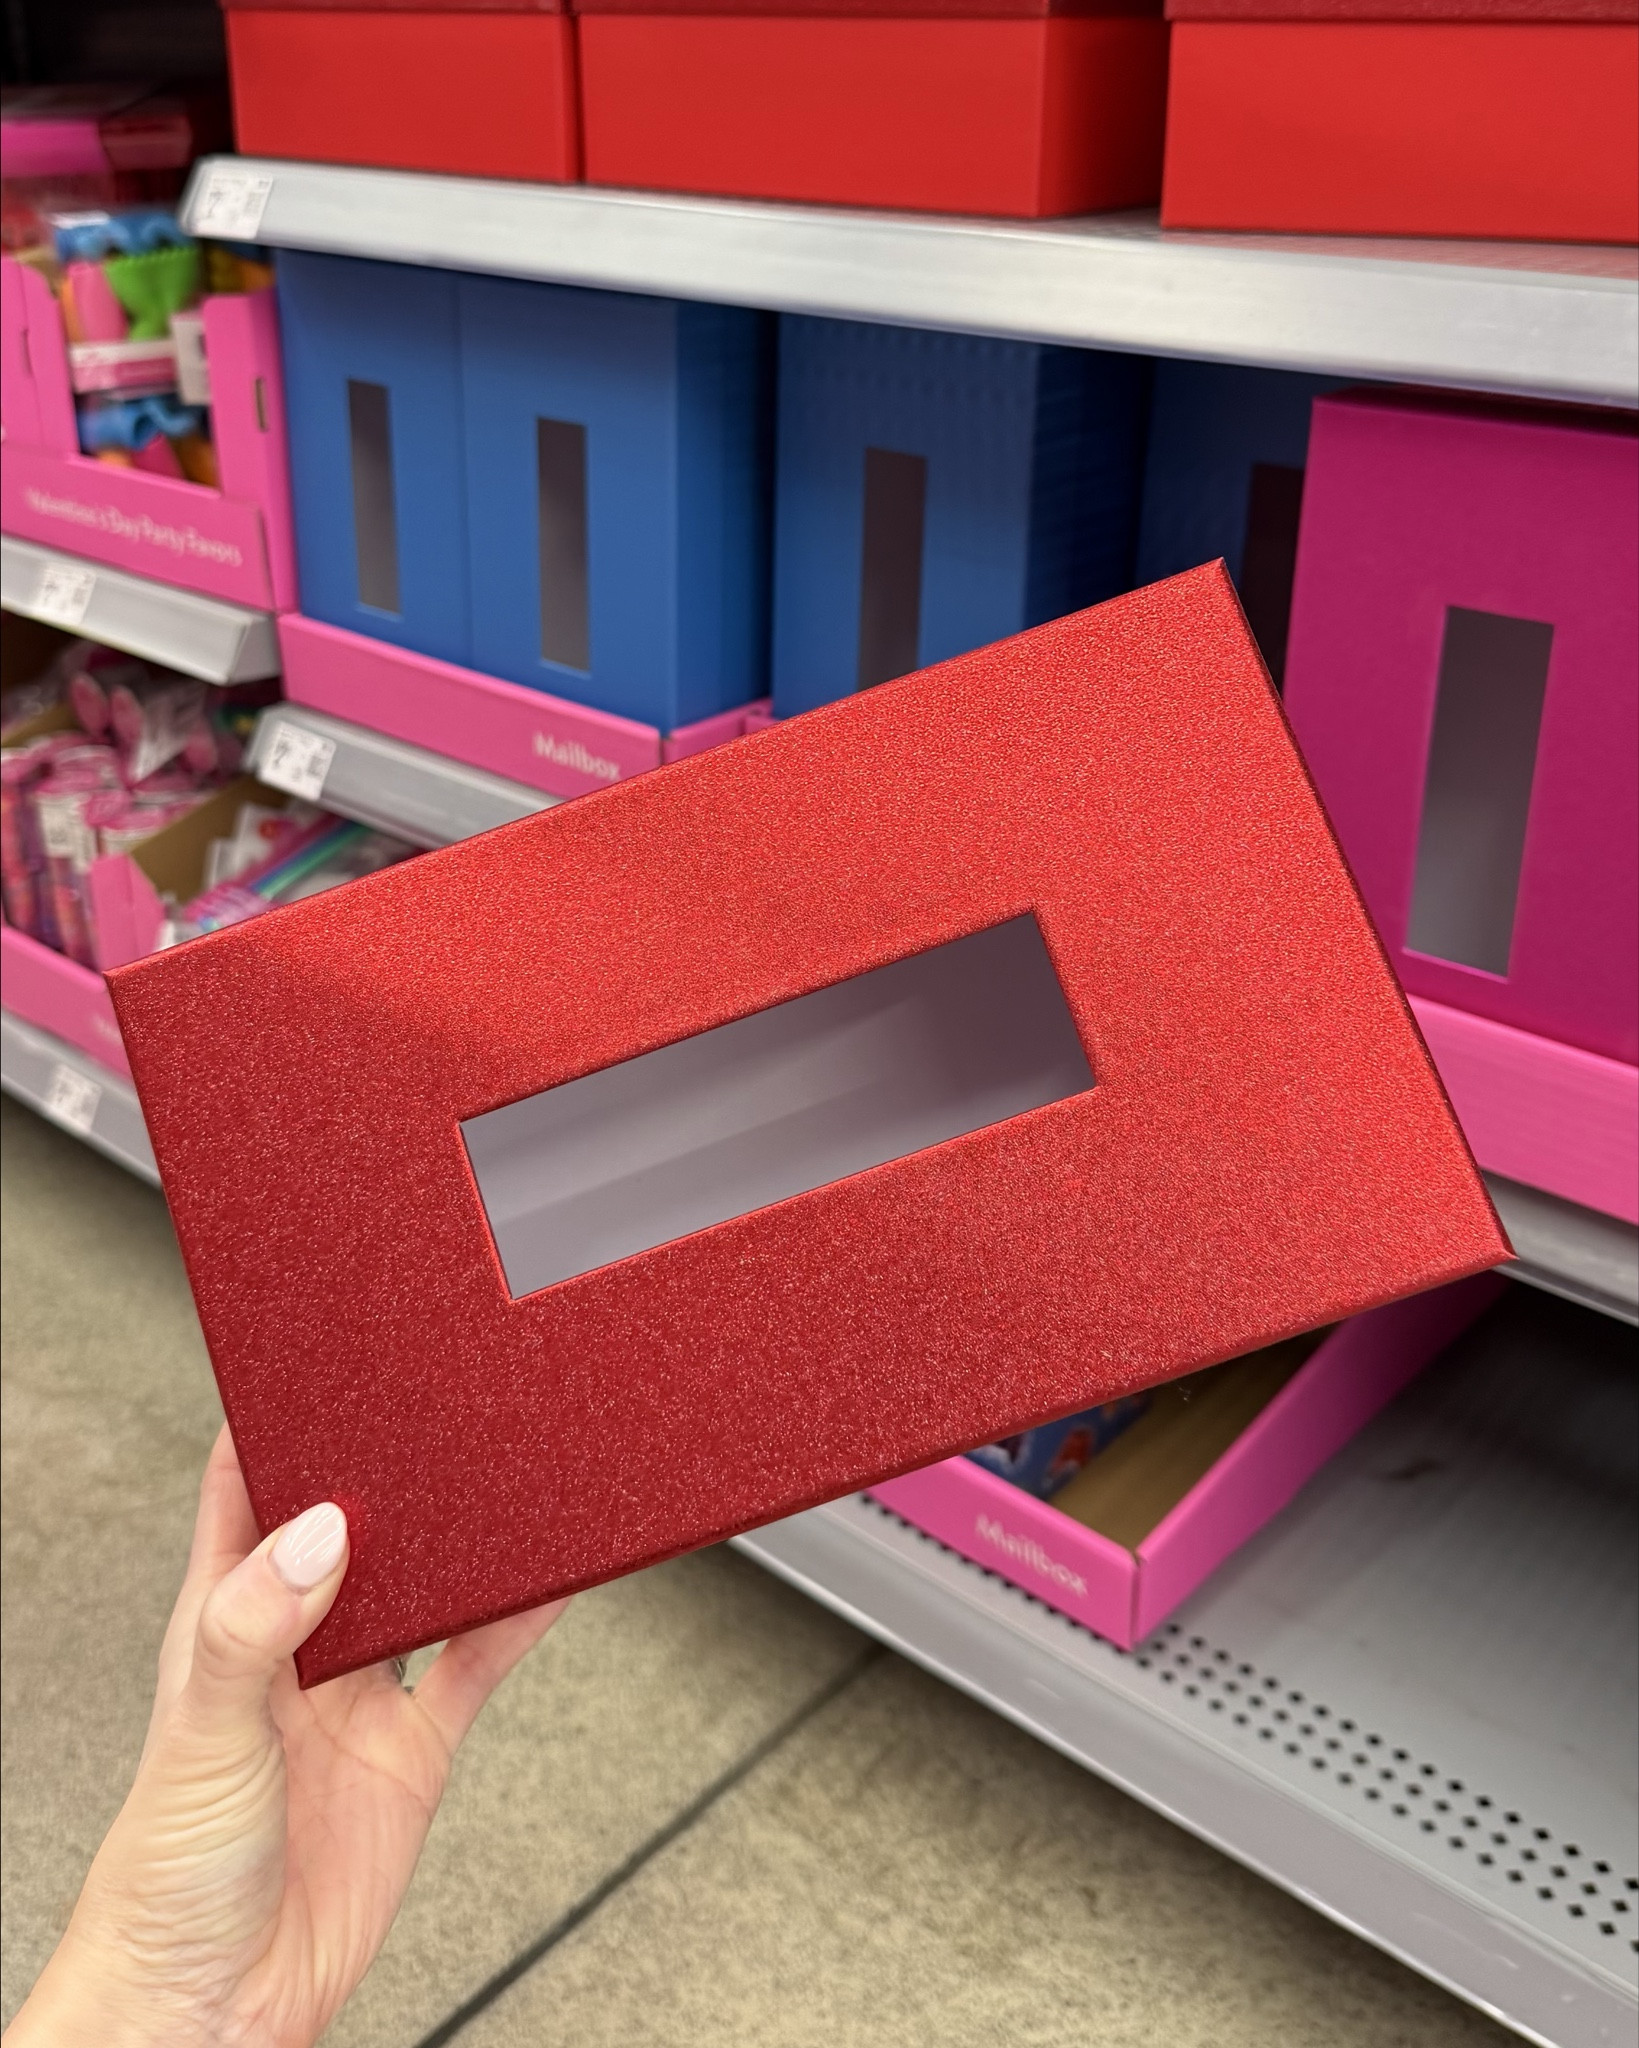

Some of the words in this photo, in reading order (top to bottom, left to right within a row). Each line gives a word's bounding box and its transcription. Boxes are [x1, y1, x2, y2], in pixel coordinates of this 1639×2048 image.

[107, 506, 139, 542] Day
[140, 513, 184, 557] Party
[534, 733, 619, 781] Mailbox
[977, 1515, 1087, 1595] Mailbox
